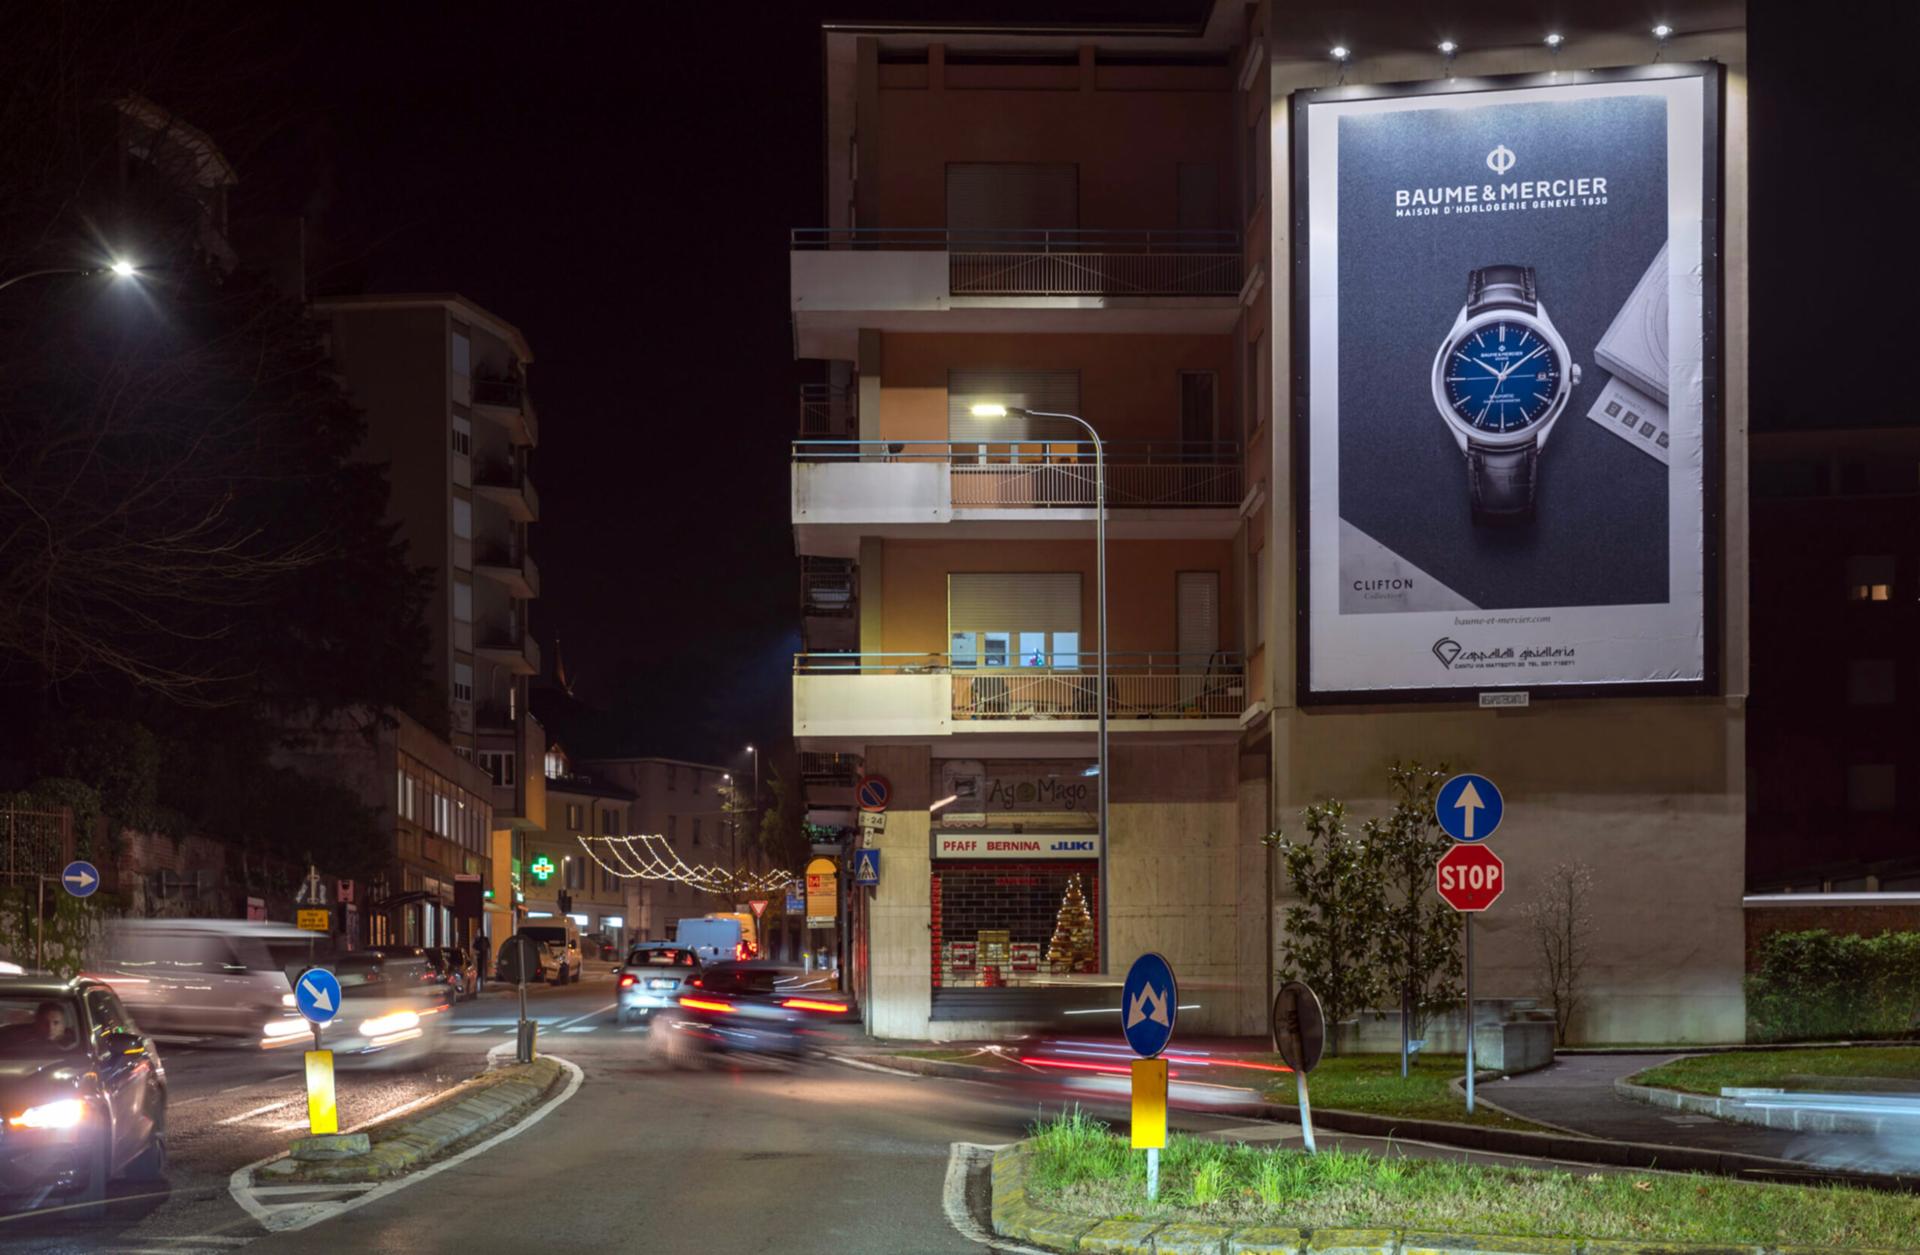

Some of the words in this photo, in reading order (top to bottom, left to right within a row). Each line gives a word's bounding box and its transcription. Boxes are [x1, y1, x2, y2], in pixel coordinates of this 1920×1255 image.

[1396, 185, 1478, 207] BAUME
[1501, 177, 1608, 200] MERCIER
[1396, 207, 1438, 217] MAISON
[1444, 201, 1527, 214] D'HORLOGERIE
[1532, 198, 1577, 209] GENEVE
[1582, 197, 1608, 206] 1830
[1353, 579, 1413, 591] CLIFTON
[1454, 616, 1551, 625] baume-et-mercier.com
[943, 841, 977, 851] PFAFF
[987, 841, 1041, 851] BERNINA
[1050, 841, 1094, 851] JUKI
[1441, 864, 1499, 890] STOP
